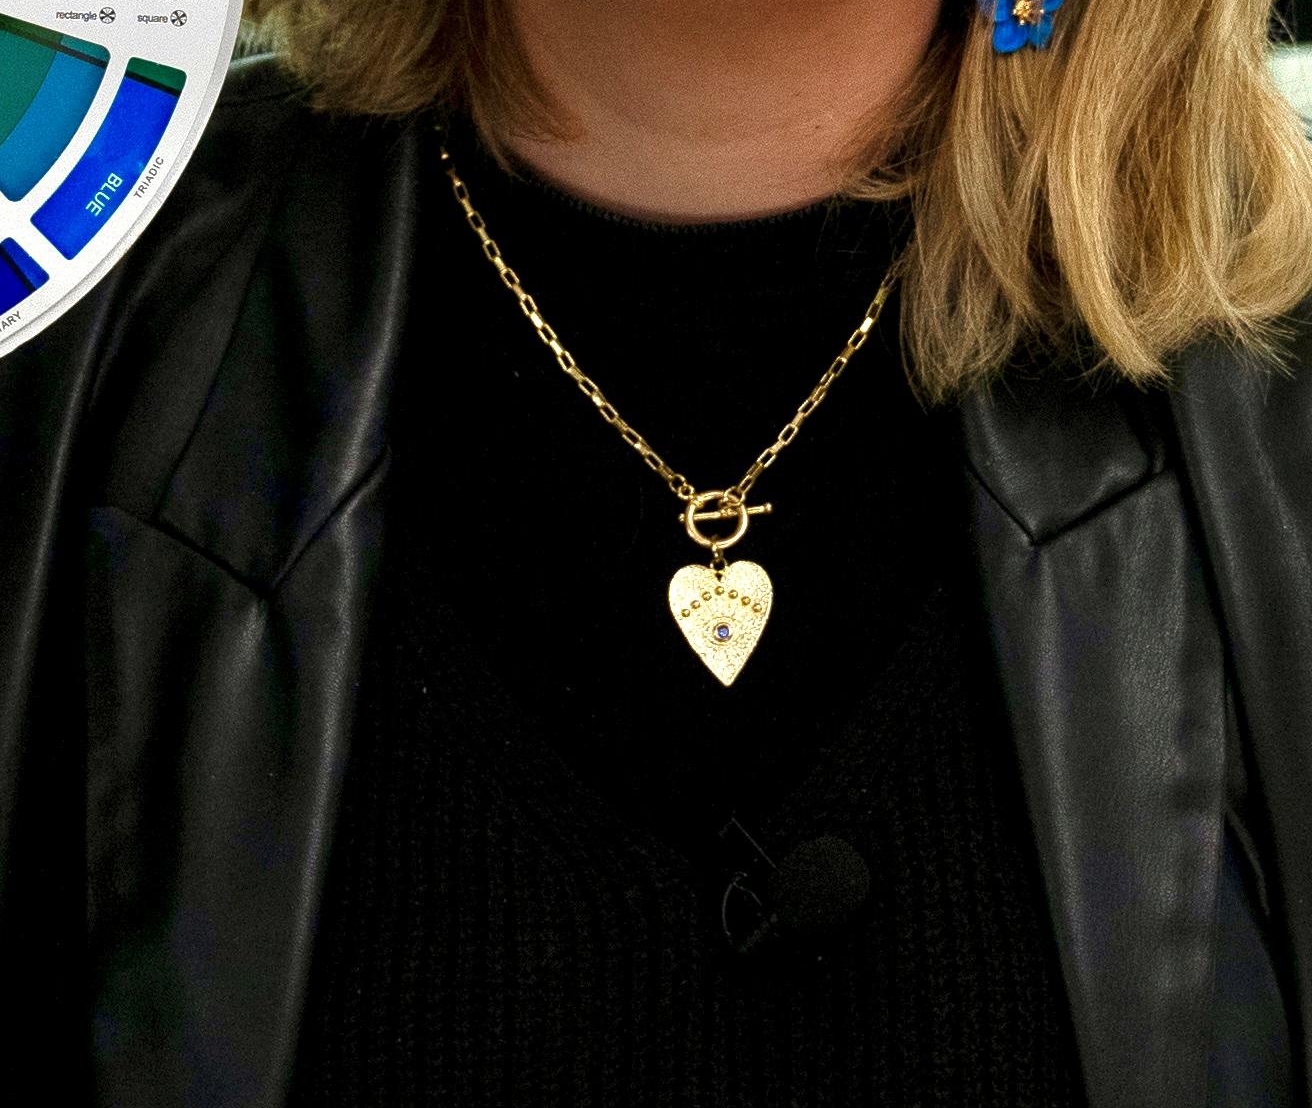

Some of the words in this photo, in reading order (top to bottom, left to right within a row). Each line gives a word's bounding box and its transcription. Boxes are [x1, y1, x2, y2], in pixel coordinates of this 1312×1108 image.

[56, 10, 97, 22] rectangle
[137, 15, 168, 24] square
[133, 156, 164, 199] TRIADIC
[86, 172, 123, 217] BLUE
